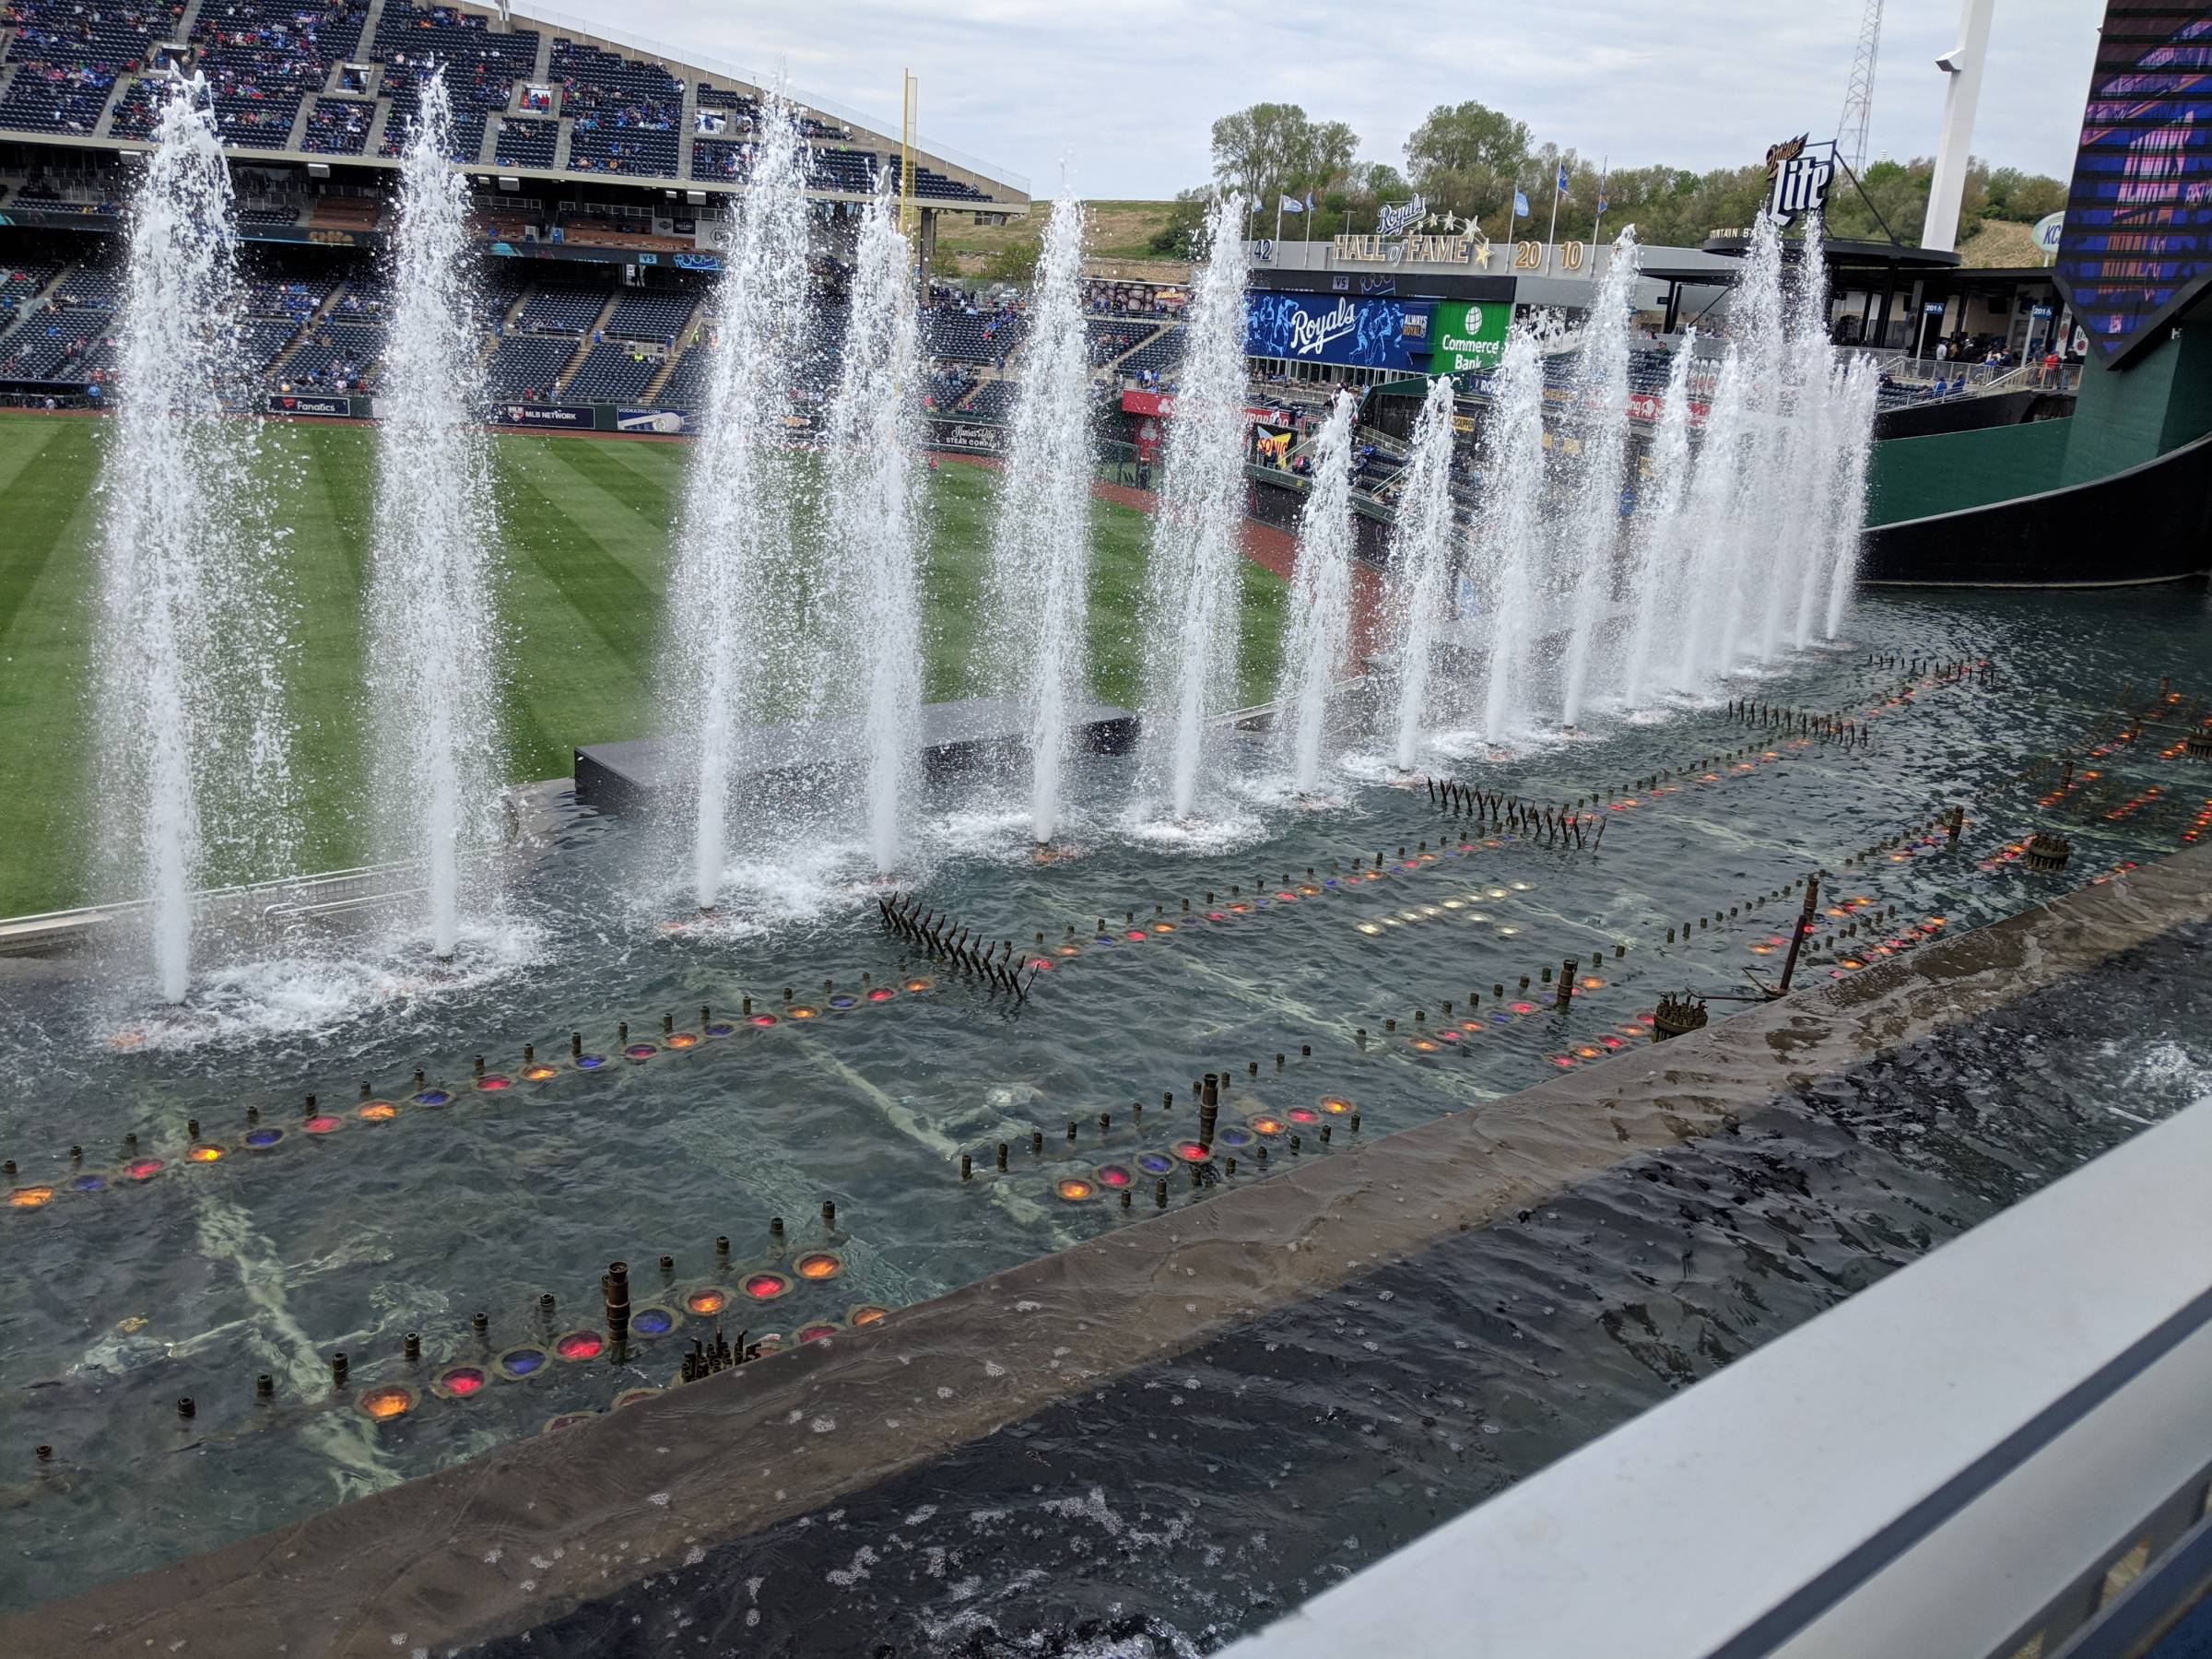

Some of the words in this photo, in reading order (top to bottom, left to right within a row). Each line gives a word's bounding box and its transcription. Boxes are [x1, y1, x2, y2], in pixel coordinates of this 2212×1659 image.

[1767, 138, 1804, 177] Miller
[1768, 157, 1830, 227] Lite
[1376, 193, 1427, 238] Royals
[1254, 239, 1272, 261] 42
[1333, 234, 1386, 261] HALL
[1388, 239, 1408, 267] of
[1407, 235, 1469, 264] FAME
[1514, 241, 1542, 269] 20
[1559, 241, 1583, 269] 10
[1290, 296, 1356, 355] Royals
[1404, 314, 1428, 325] ALWAYS
[1441, 334, 1500, 356] Commerce
[1454, 353, 1484, 370] Bank
[297, 401, 335, 413] Fanatics
[541, 411, 576, 420] NETWORK
[946, 437, 968, 445] STEAK
[951, 425, 977, 439] Kansas
[1259, 438, 1288, 458] SONIC
